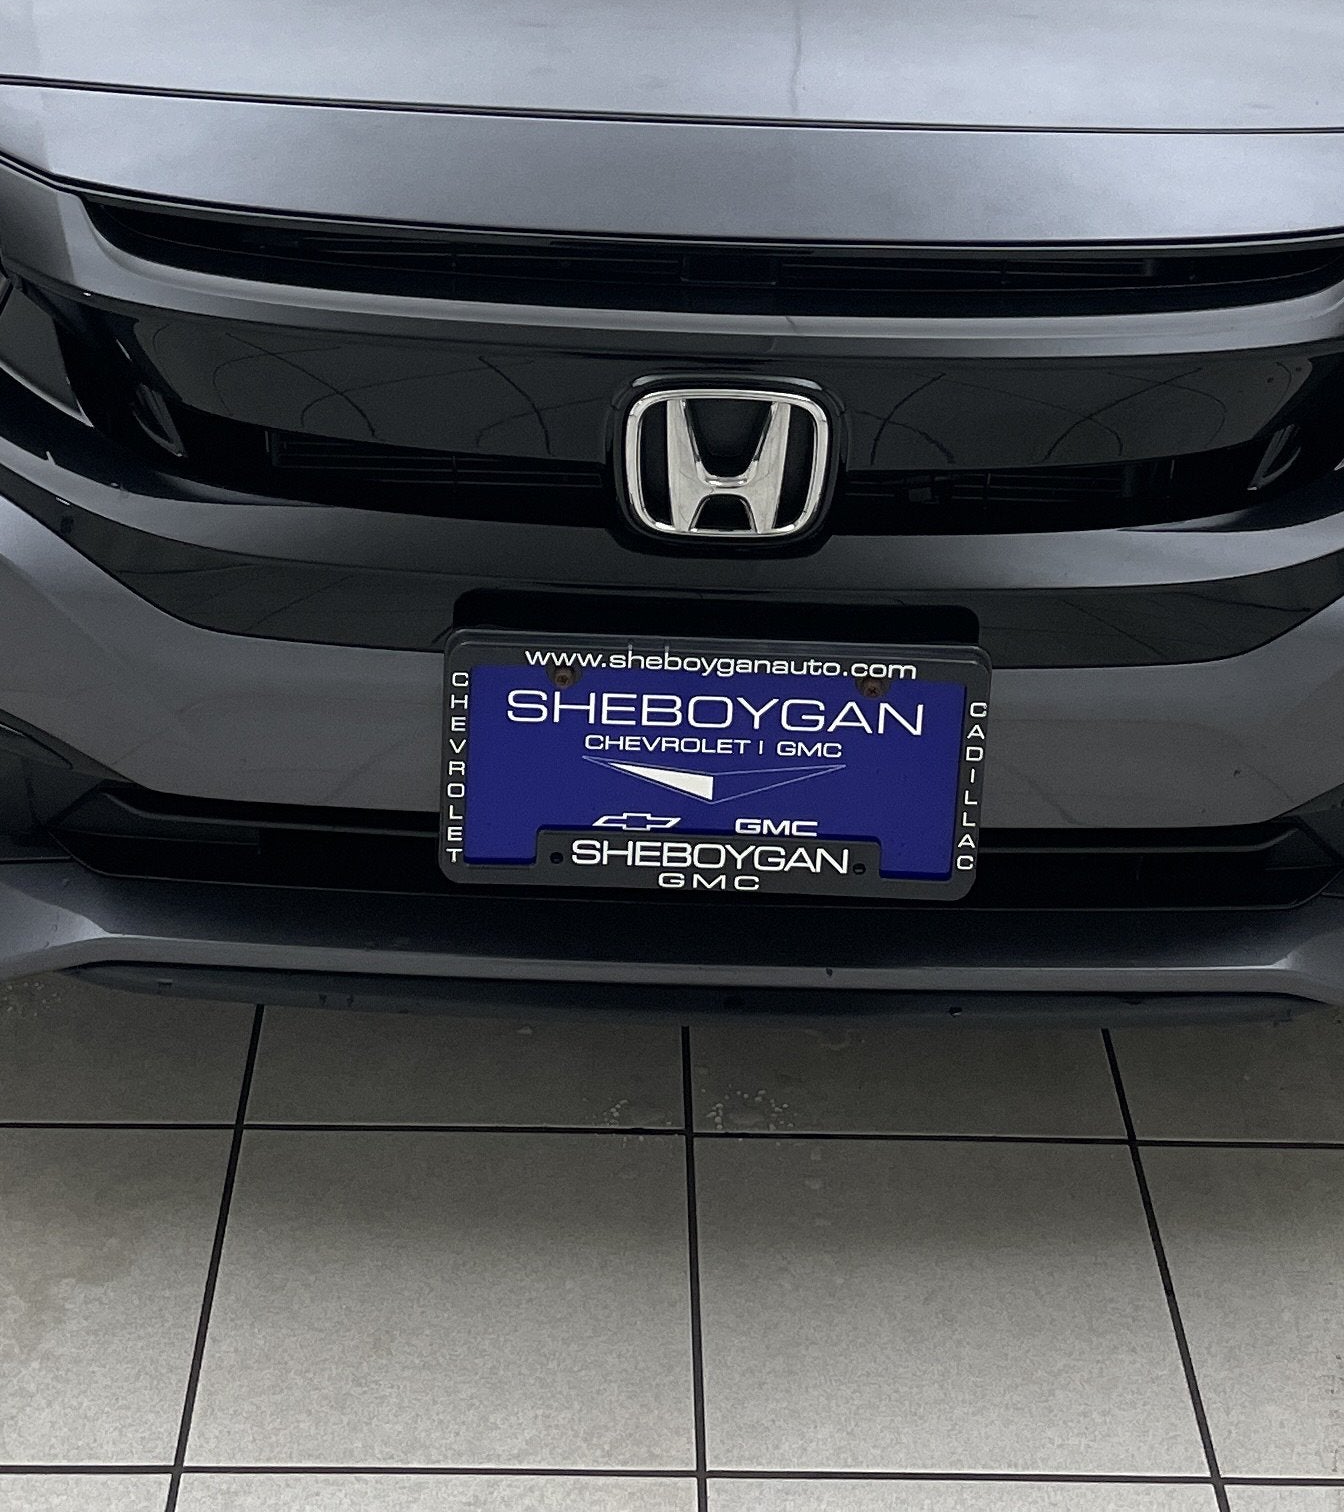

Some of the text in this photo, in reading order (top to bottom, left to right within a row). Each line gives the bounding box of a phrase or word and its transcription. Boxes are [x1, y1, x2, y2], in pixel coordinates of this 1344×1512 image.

[524, 649, 917, 680] www.sheboyganauto.com
[506, 688, 925, 737] SHEBOYGAN
[583, 733, 752, 755] CHEVROLET
[775, 740, 843, 759] GMC
[445, 672, 469, 864] CHEVROLET
[955, 701, 989, 872] CADILLAC
[733, 817, 819, 838] GMC
[570, 838, 850, 875] SHEBOYGAN
[657, 871, 761, 892] GMC
